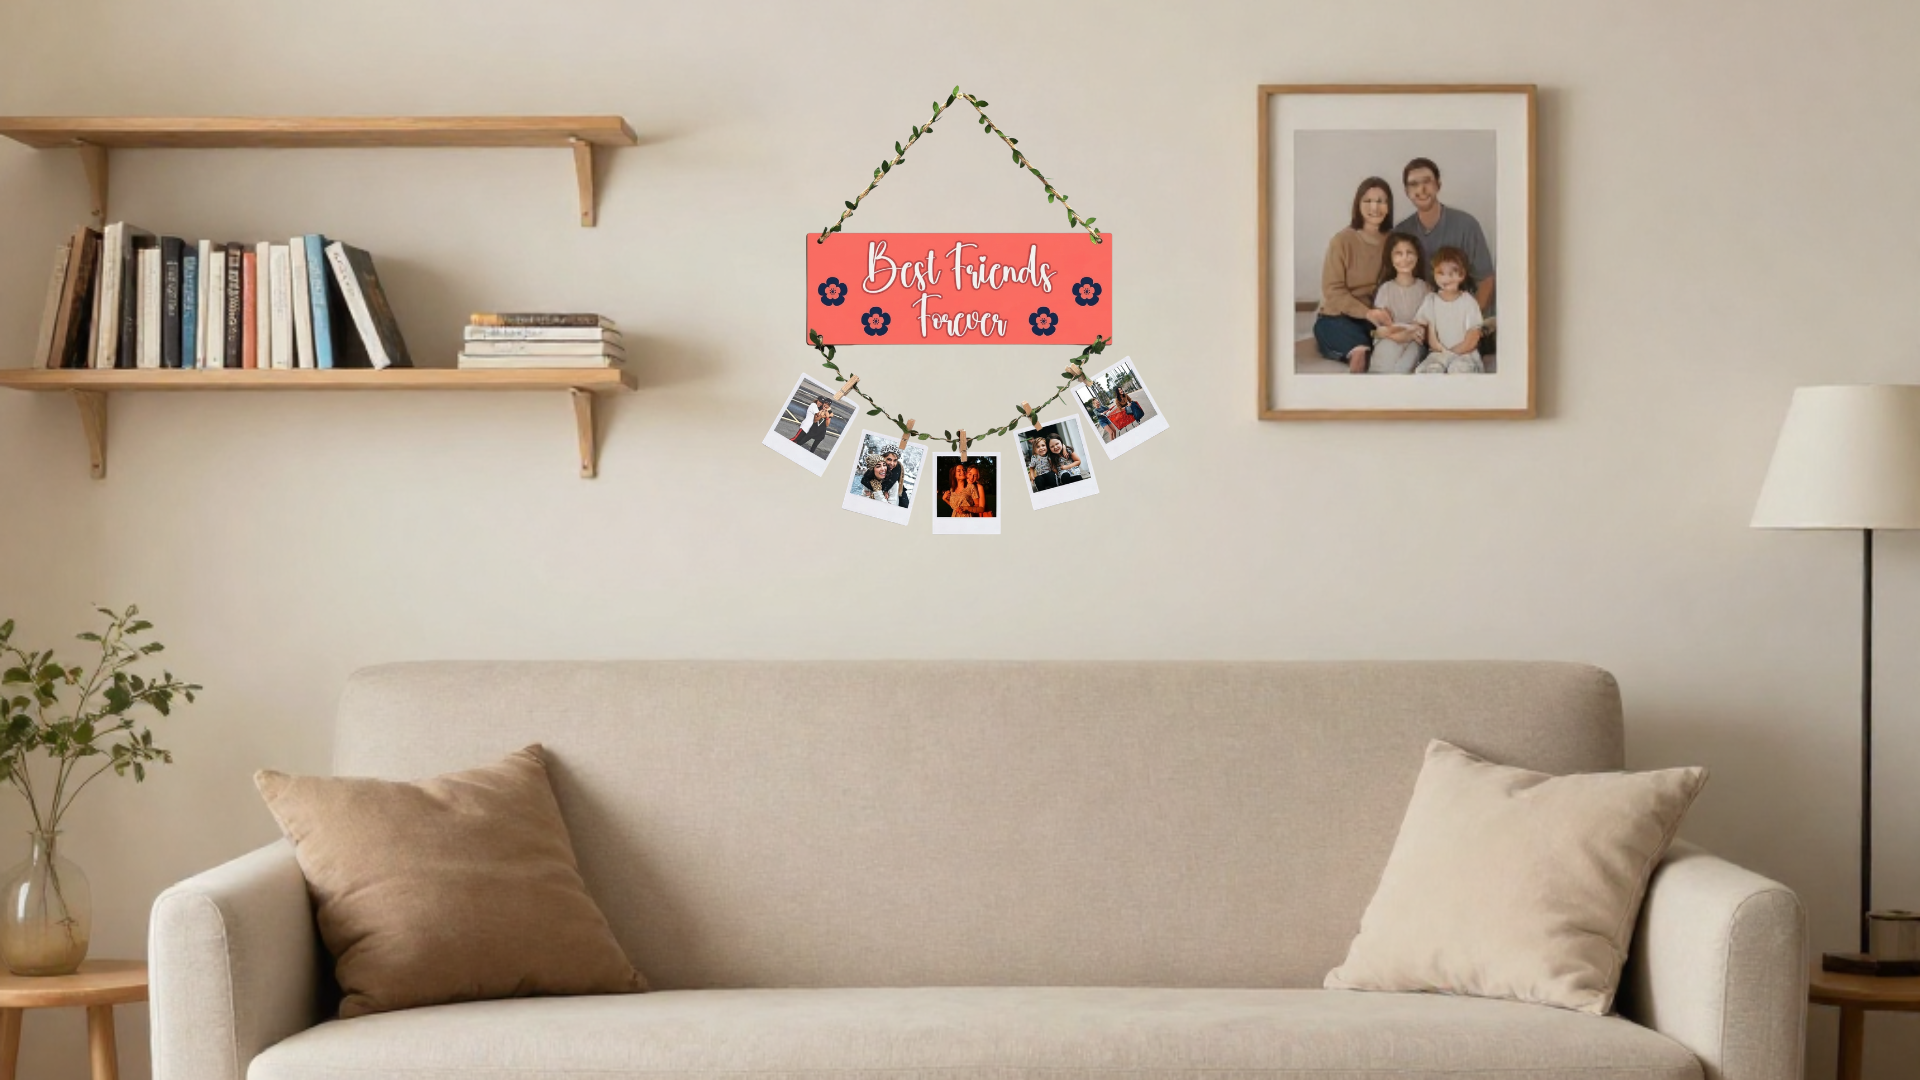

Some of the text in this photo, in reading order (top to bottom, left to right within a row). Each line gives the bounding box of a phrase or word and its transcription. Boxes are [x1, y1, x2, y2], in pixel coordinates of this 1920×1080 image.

[862, 240, 1057, 293] Best Friends
[912, 292, 1007, 337] Forever
